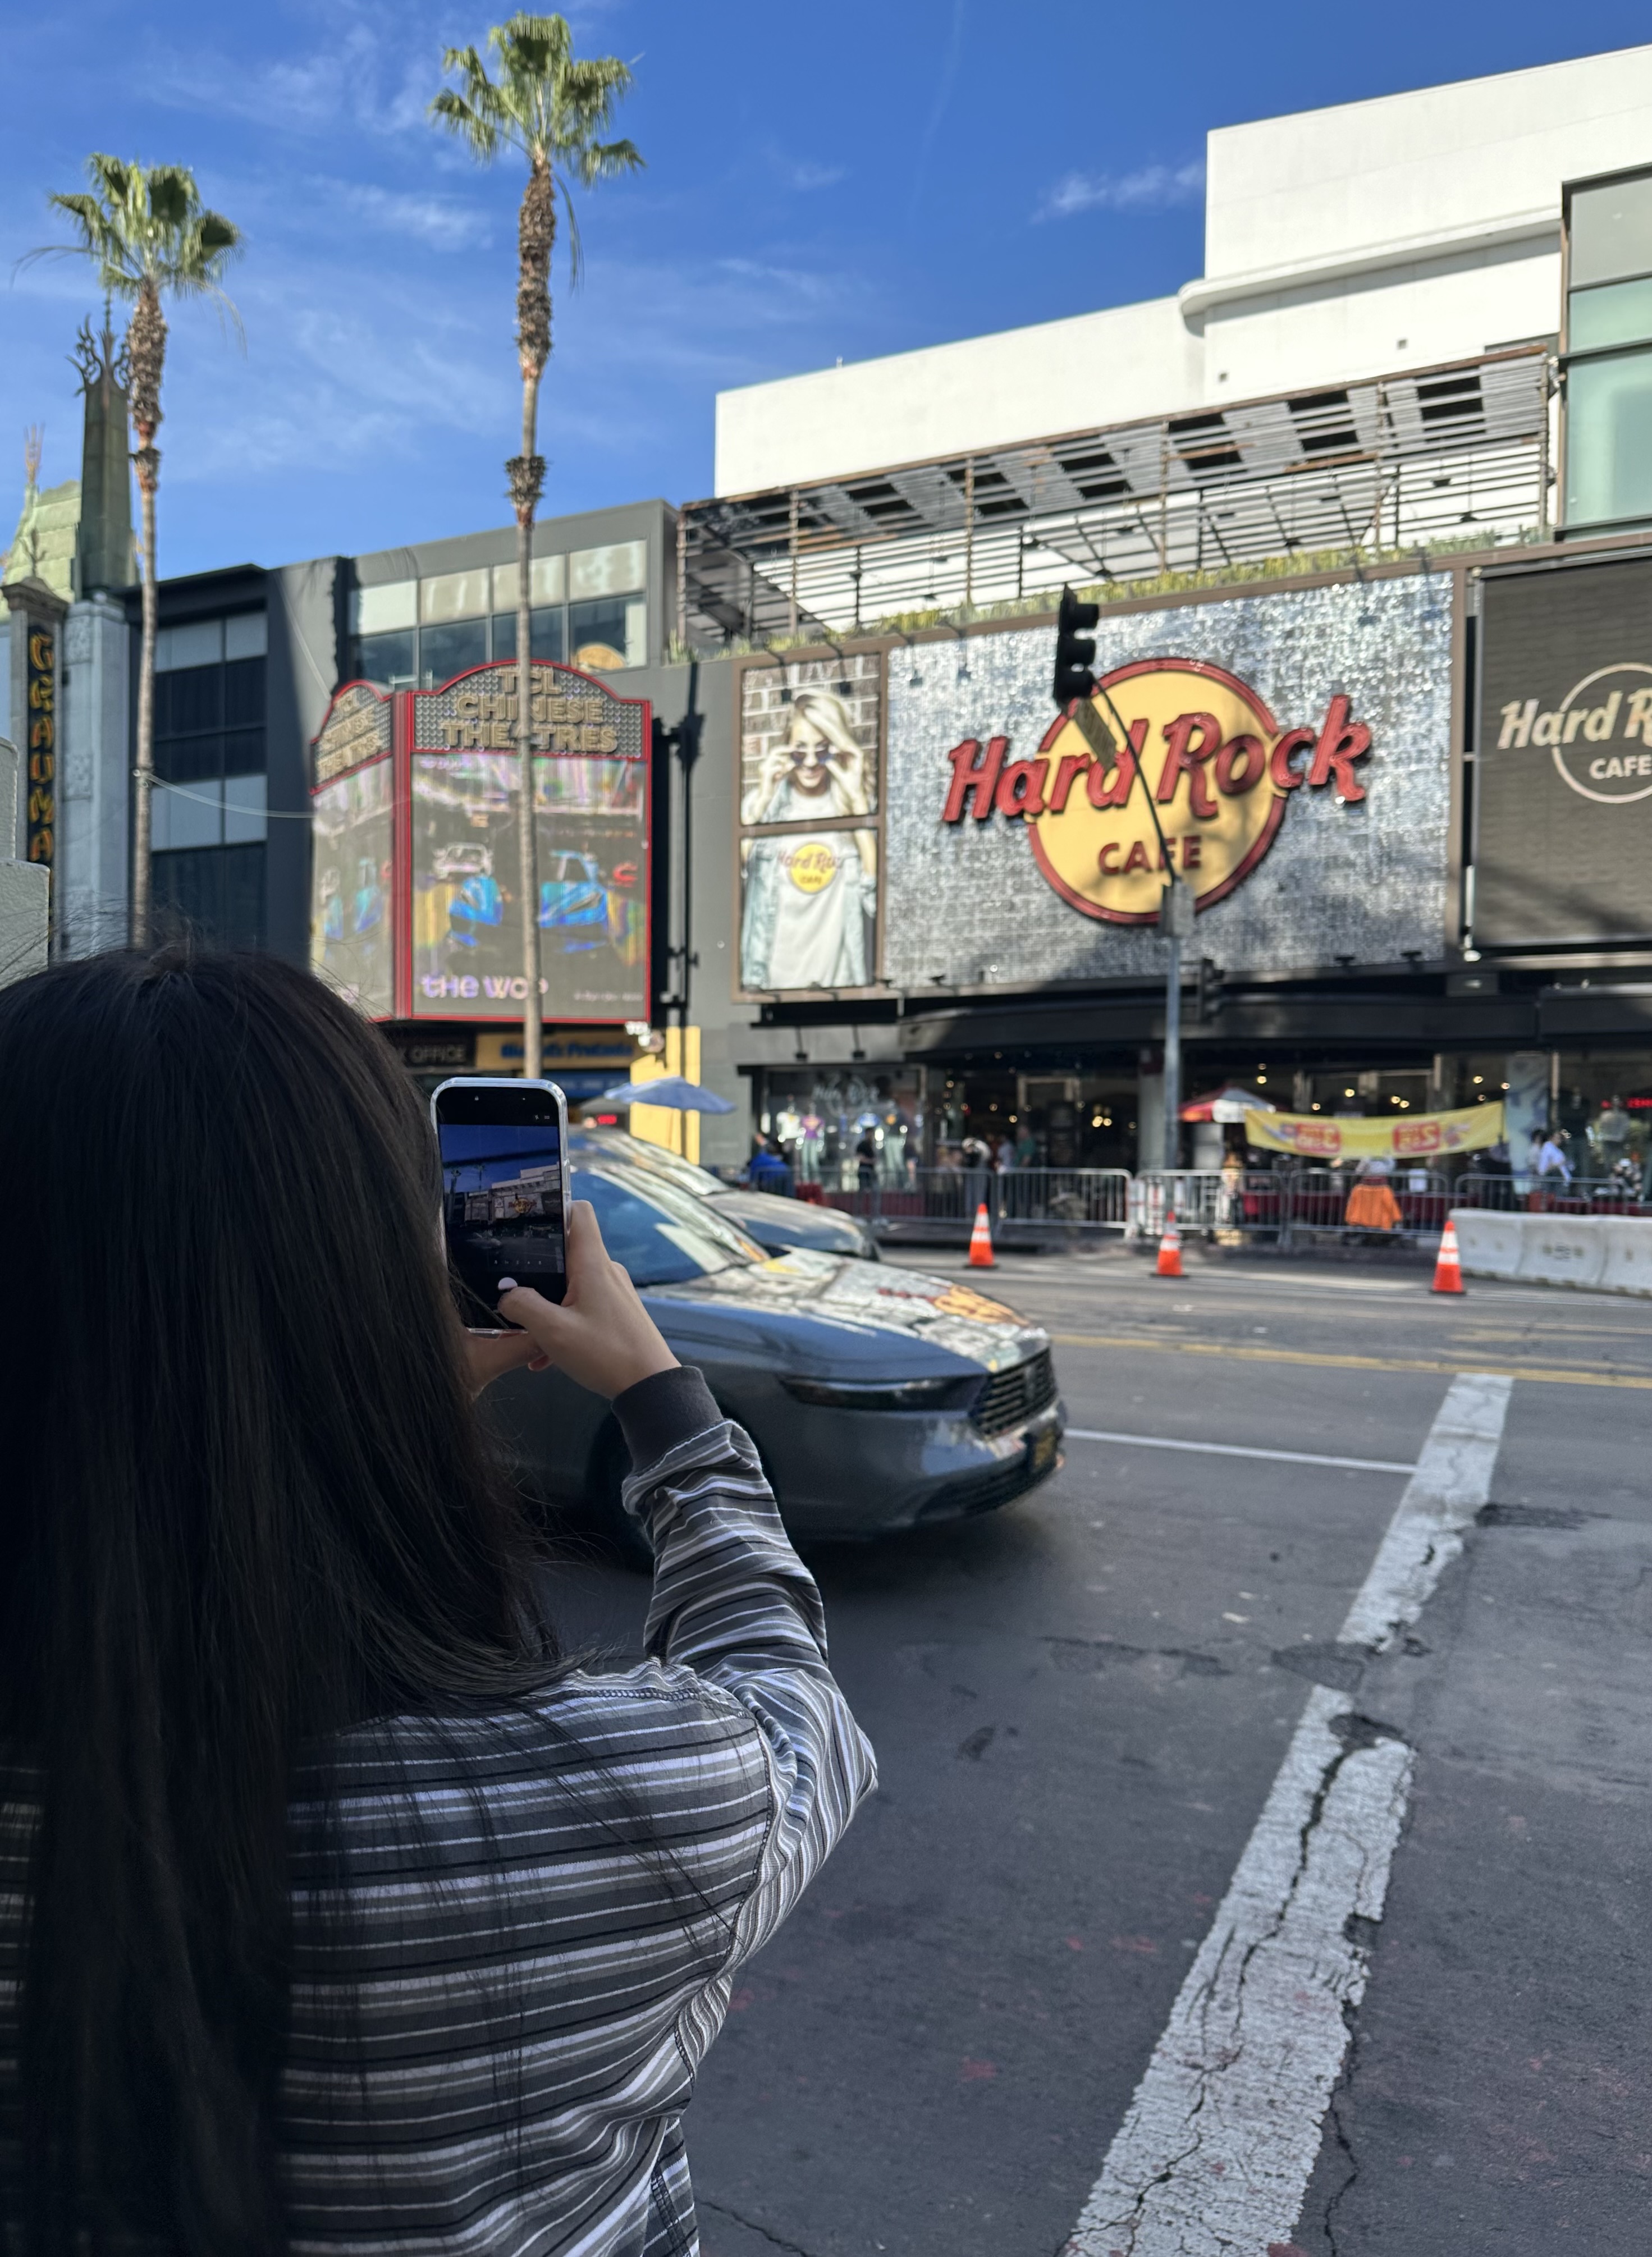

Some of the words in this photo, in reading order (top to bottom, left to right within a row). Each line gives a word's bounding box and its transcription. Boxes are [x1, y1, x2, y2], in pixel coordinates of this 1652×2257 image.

[456, 694, 604, 724] CHINESE
[1497, 690, 1623, 750] Hard
[440, 722, 618, 753] THETRES
[29, 633, 54, 884] GRAUMA
[942, 719, 1150, 823] Hard
[1156, 695, 1372, 818] Rock
[1589, 754, 1652, 780] CAFE
[1099, 835, 1202, 875] CAFE
